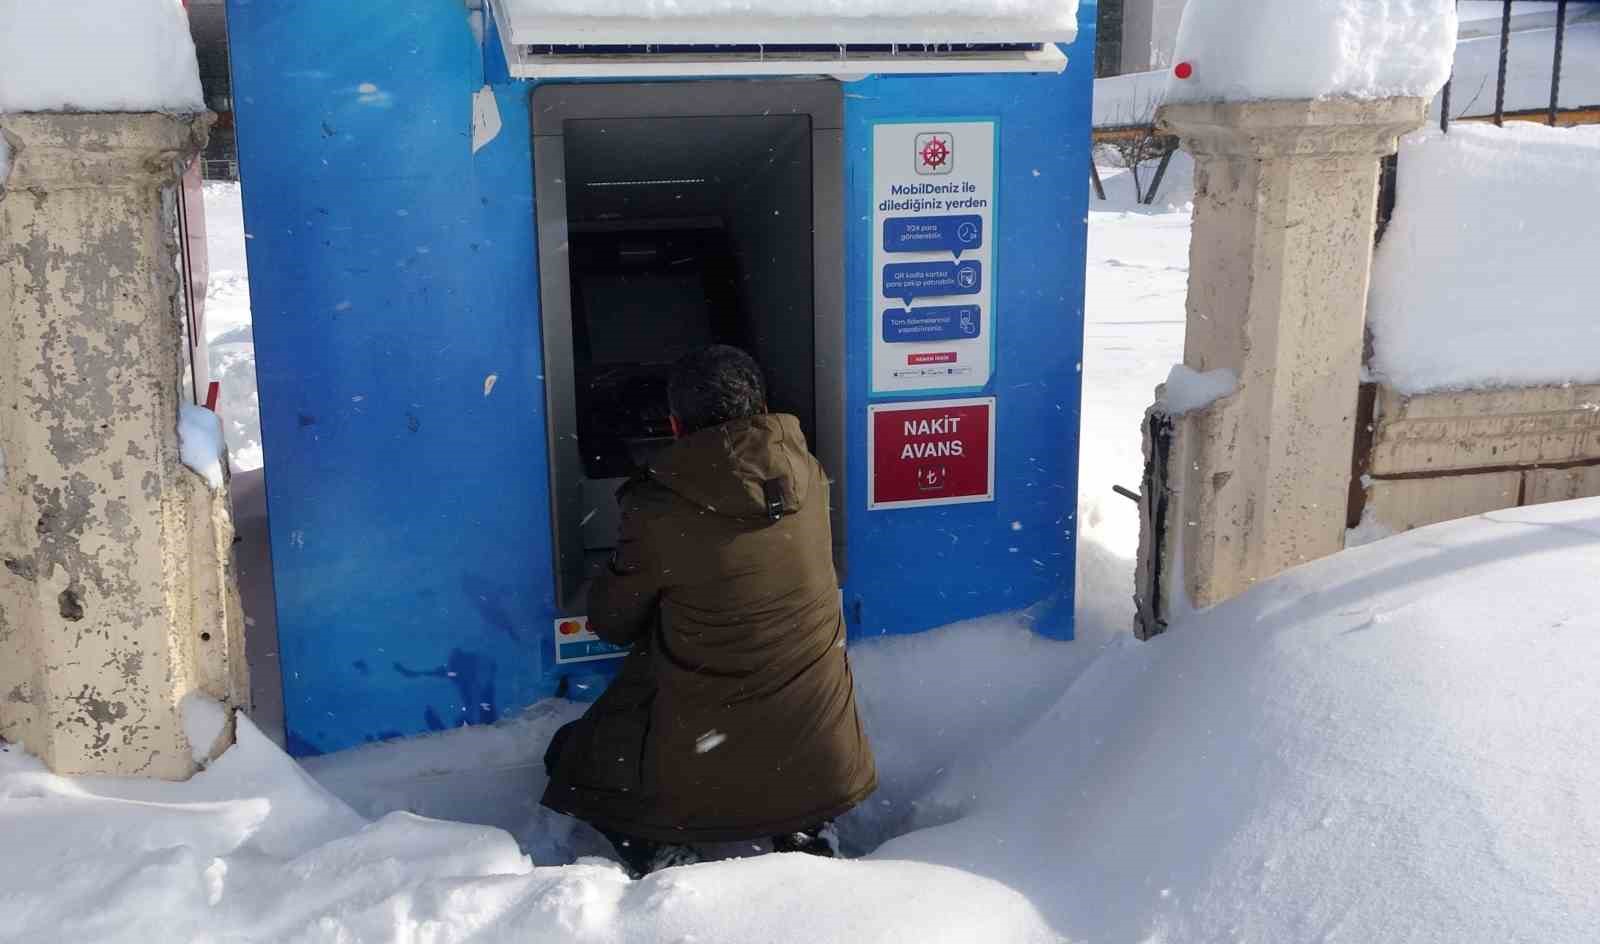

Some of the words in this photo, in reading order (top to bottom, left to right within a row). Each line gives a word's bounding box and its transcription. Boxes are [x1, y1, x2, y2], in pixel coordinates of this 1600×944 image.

[891, 182, 960, 196] MobilDeniz
[961, 181, 976, 193] ile
[879, 199, 942, 212] dilediğiniz
[945, 197, 987, 210] yerden
[904, 414, 961, 436] NAKİT
[901, 440, 962, 459] AVANS
